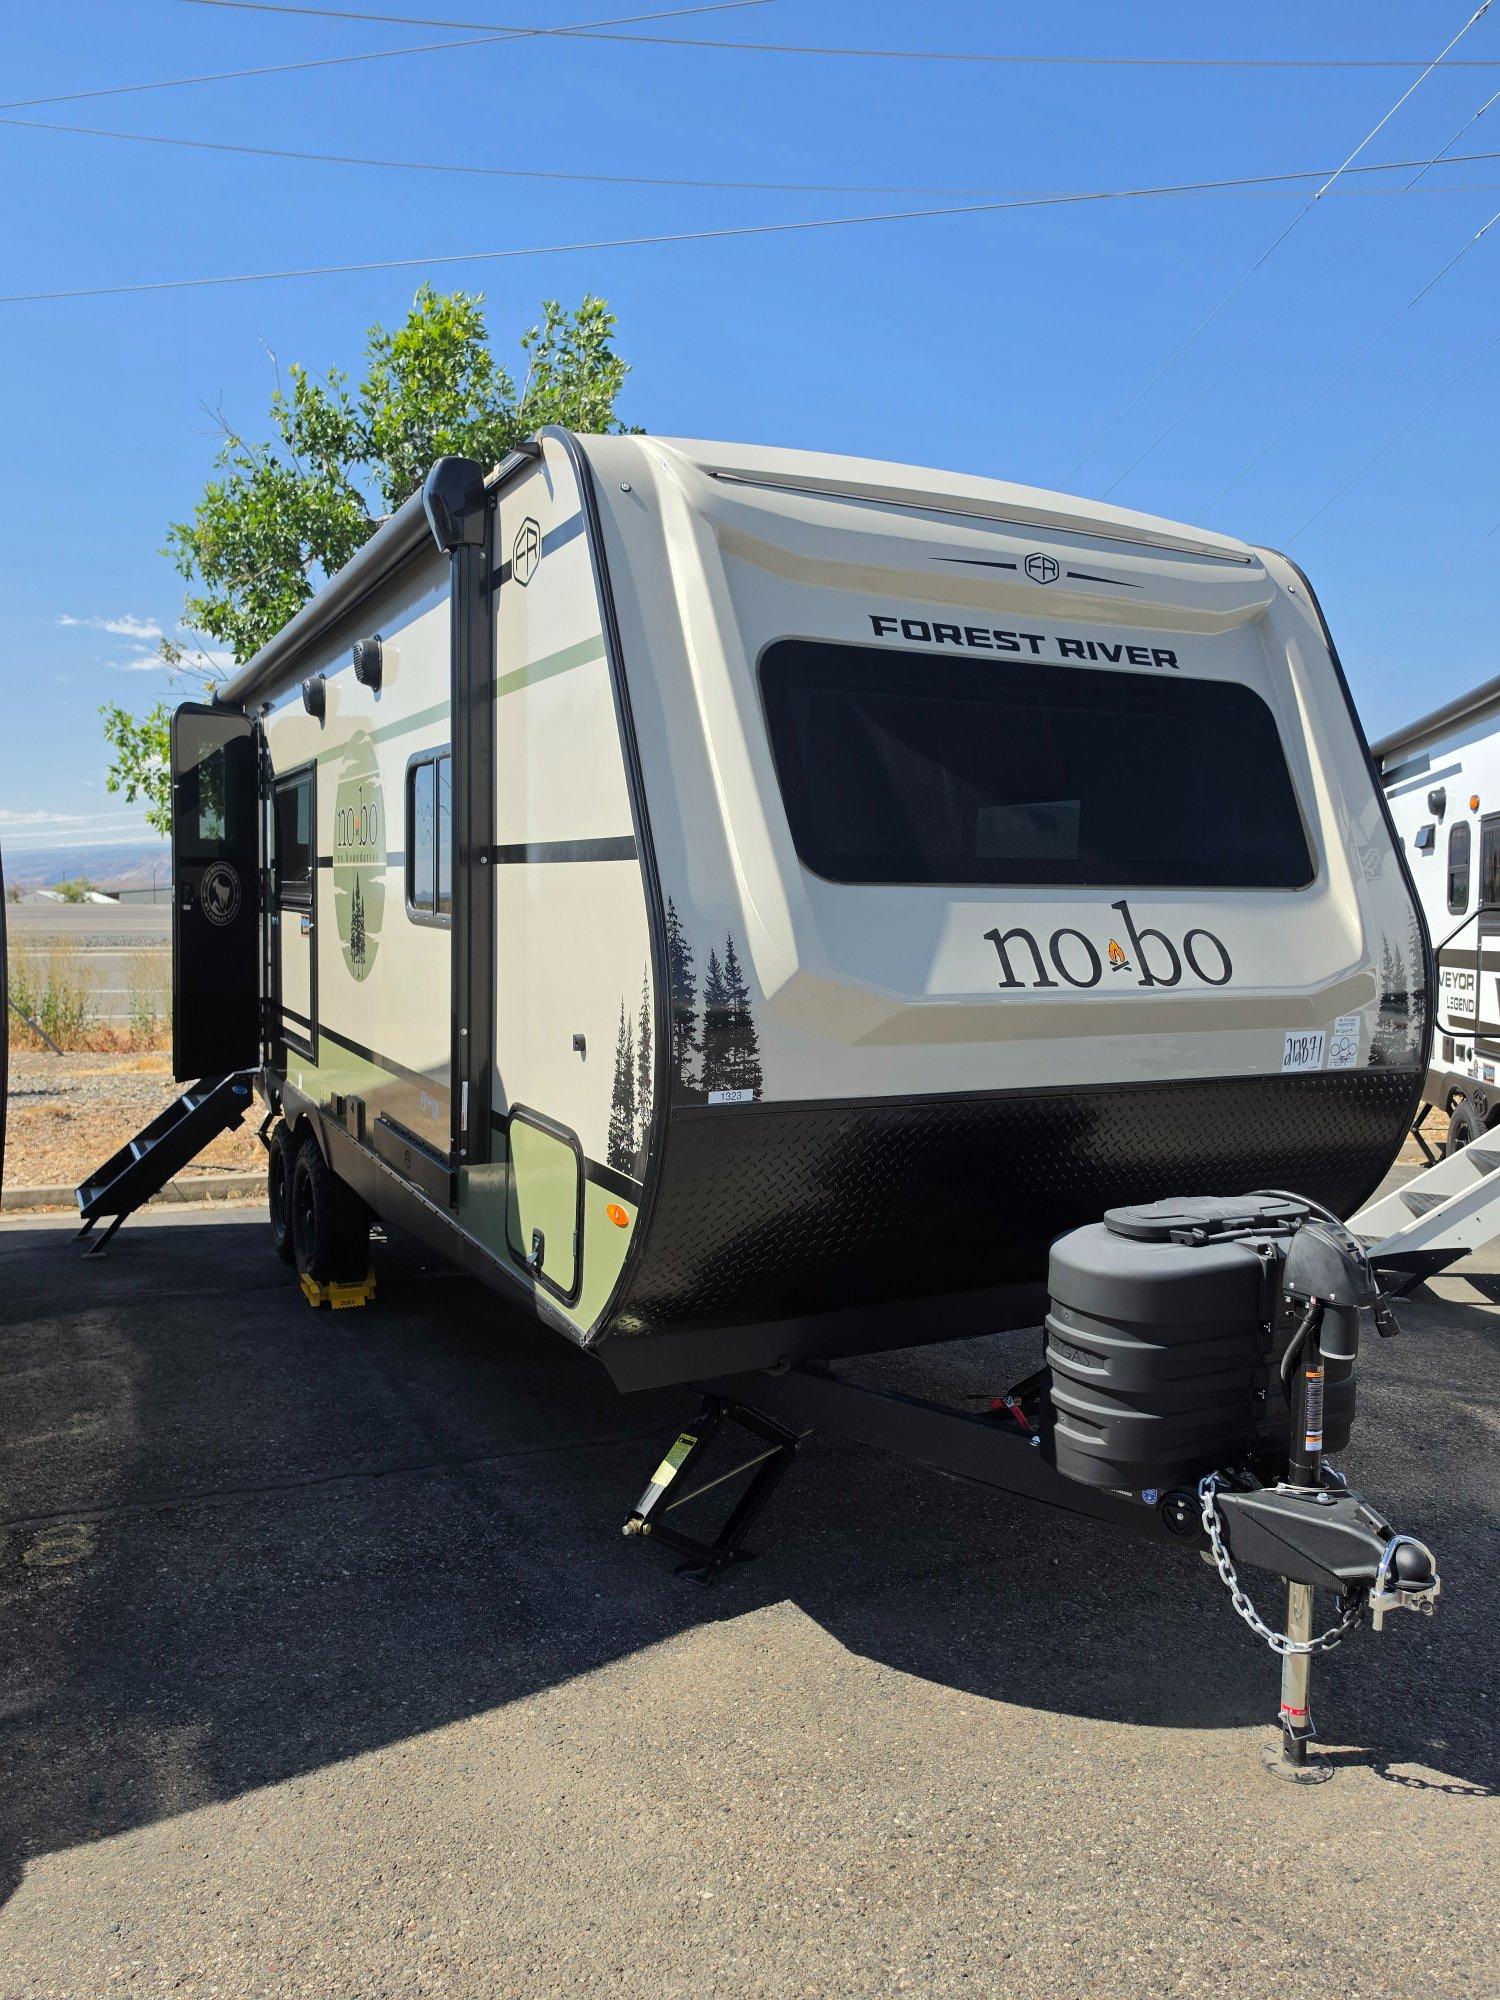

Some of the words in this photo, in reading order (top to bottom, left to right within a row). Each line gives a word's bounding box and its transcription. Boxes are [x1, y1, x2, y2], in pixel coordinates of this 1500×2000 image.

[867, 614, 1046, 655] FOREST
[1054, 637, 1180, 669] RIVER
[1446, 995, 1475, 1013] LEGEND
[721, 1091, 742, 1101] 1323
[1062, 1344, 1090, 1367] GAS
